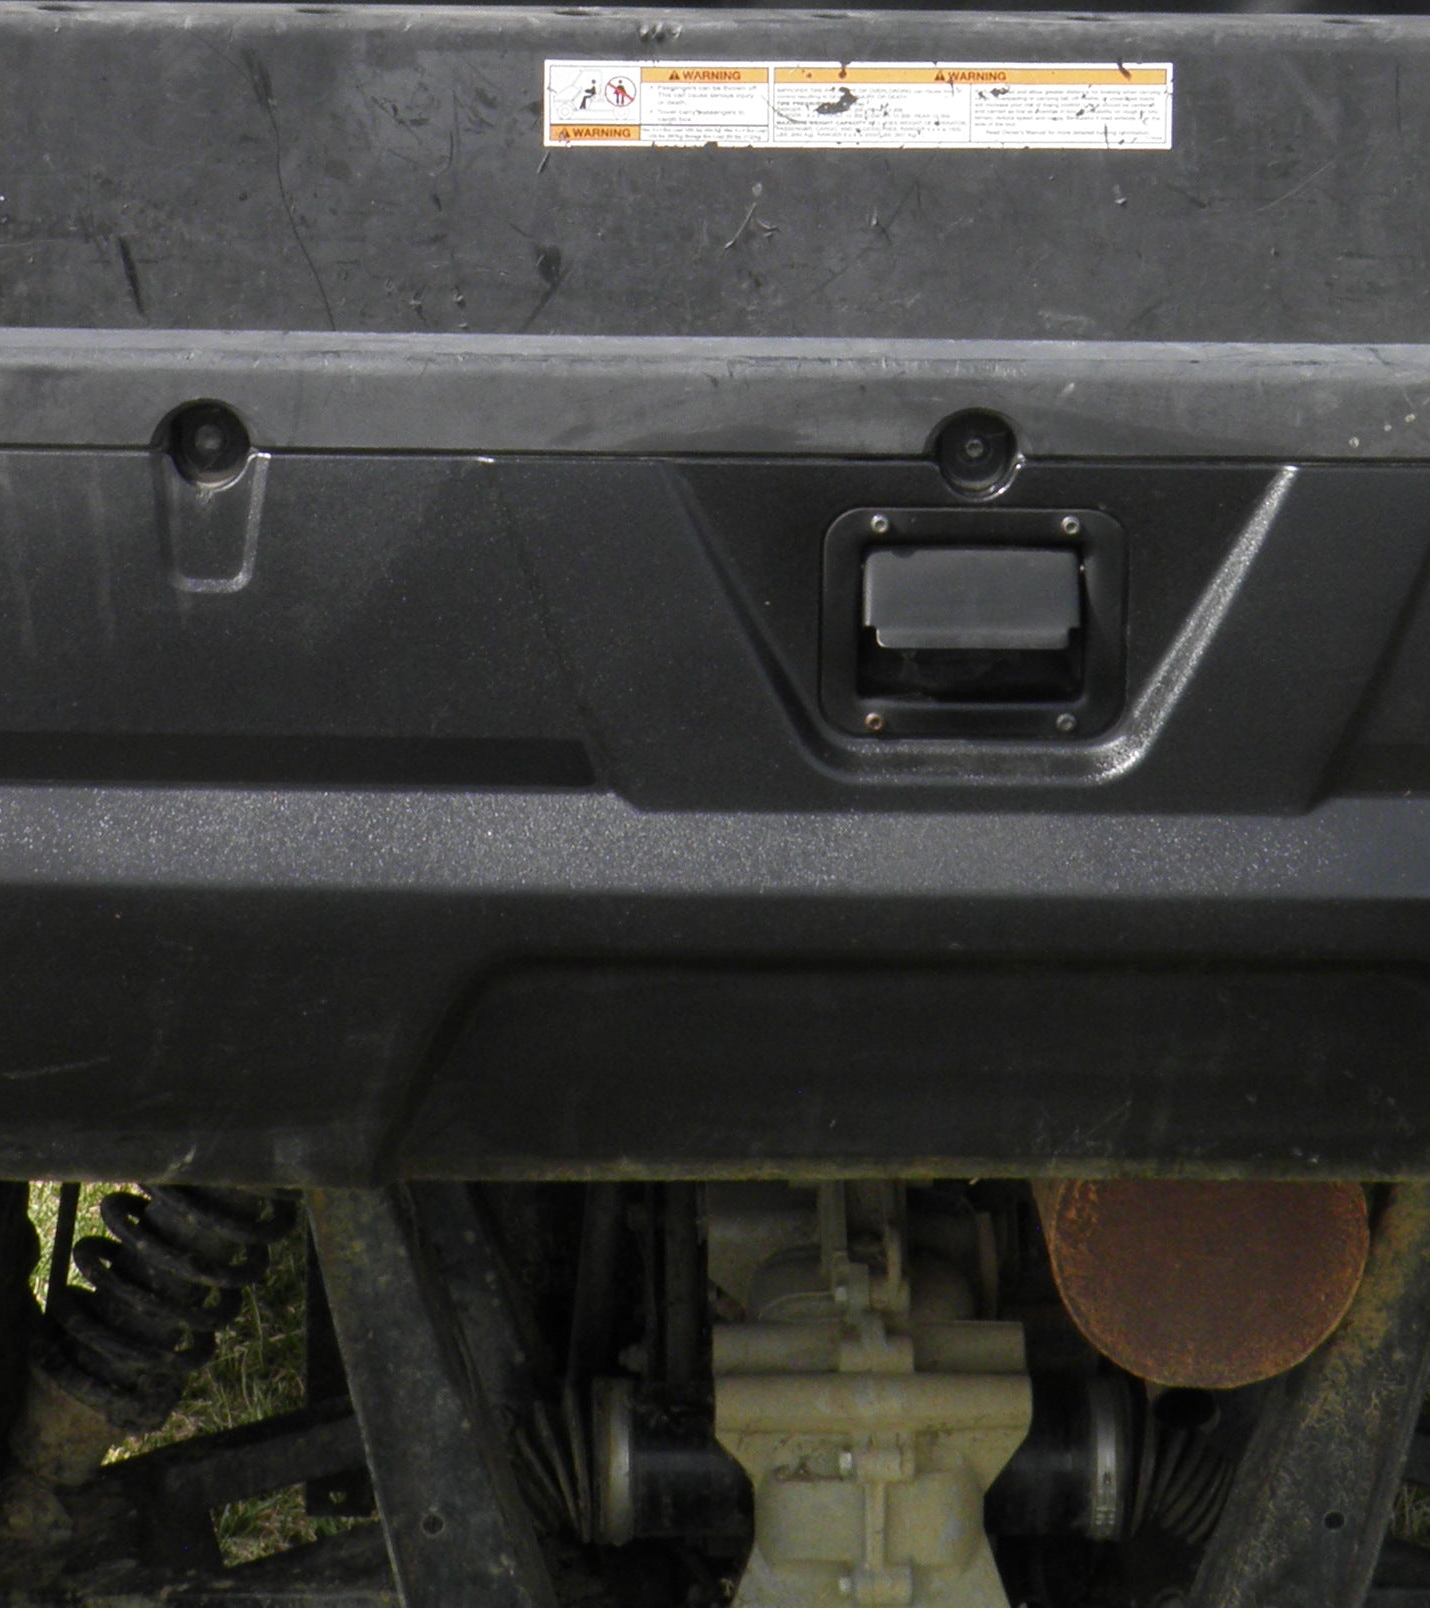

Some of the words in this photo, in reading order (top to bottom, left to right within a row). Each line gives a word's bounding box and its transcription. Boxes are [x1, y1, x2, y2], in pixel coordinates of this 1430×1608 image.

[682, 70, 742, 81] WARNING
[947, 71, 1007, 82] WARNING
[572, 128, 631, 139] WARNING
